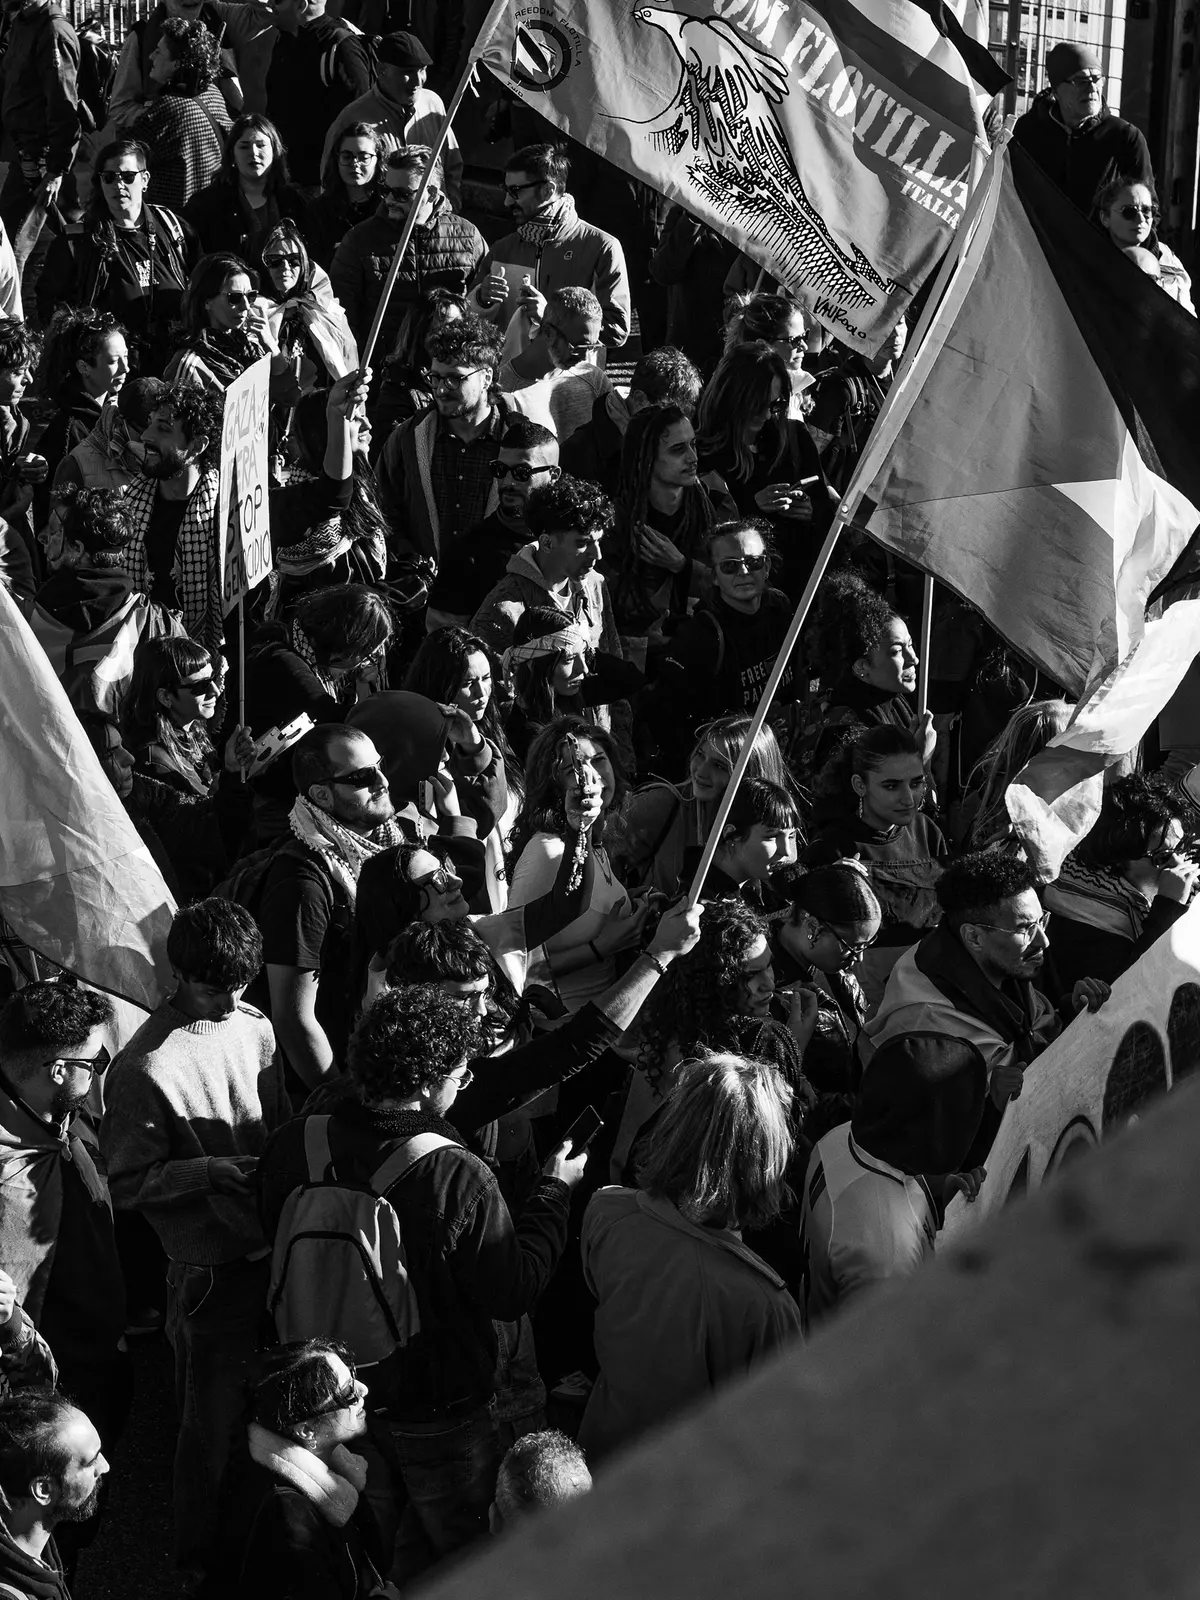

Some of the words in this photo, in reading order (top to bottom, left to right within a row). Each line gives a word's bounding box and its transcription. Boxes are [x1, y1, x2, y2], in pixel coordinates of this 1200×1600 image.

[514, 6, 554, 20] REEDOM
[559, 18, 582, 67] FLOTILLA
[781, 17, 970, 212] FLOTILLA
[901, 180, 961, 230] ITALIA
[224, 383, 256, 453] GAZA
[227, 484, 263, 554] STOP
[741, 661, 766, 687] FREE
[743, 665, 794, 706] PAINE
